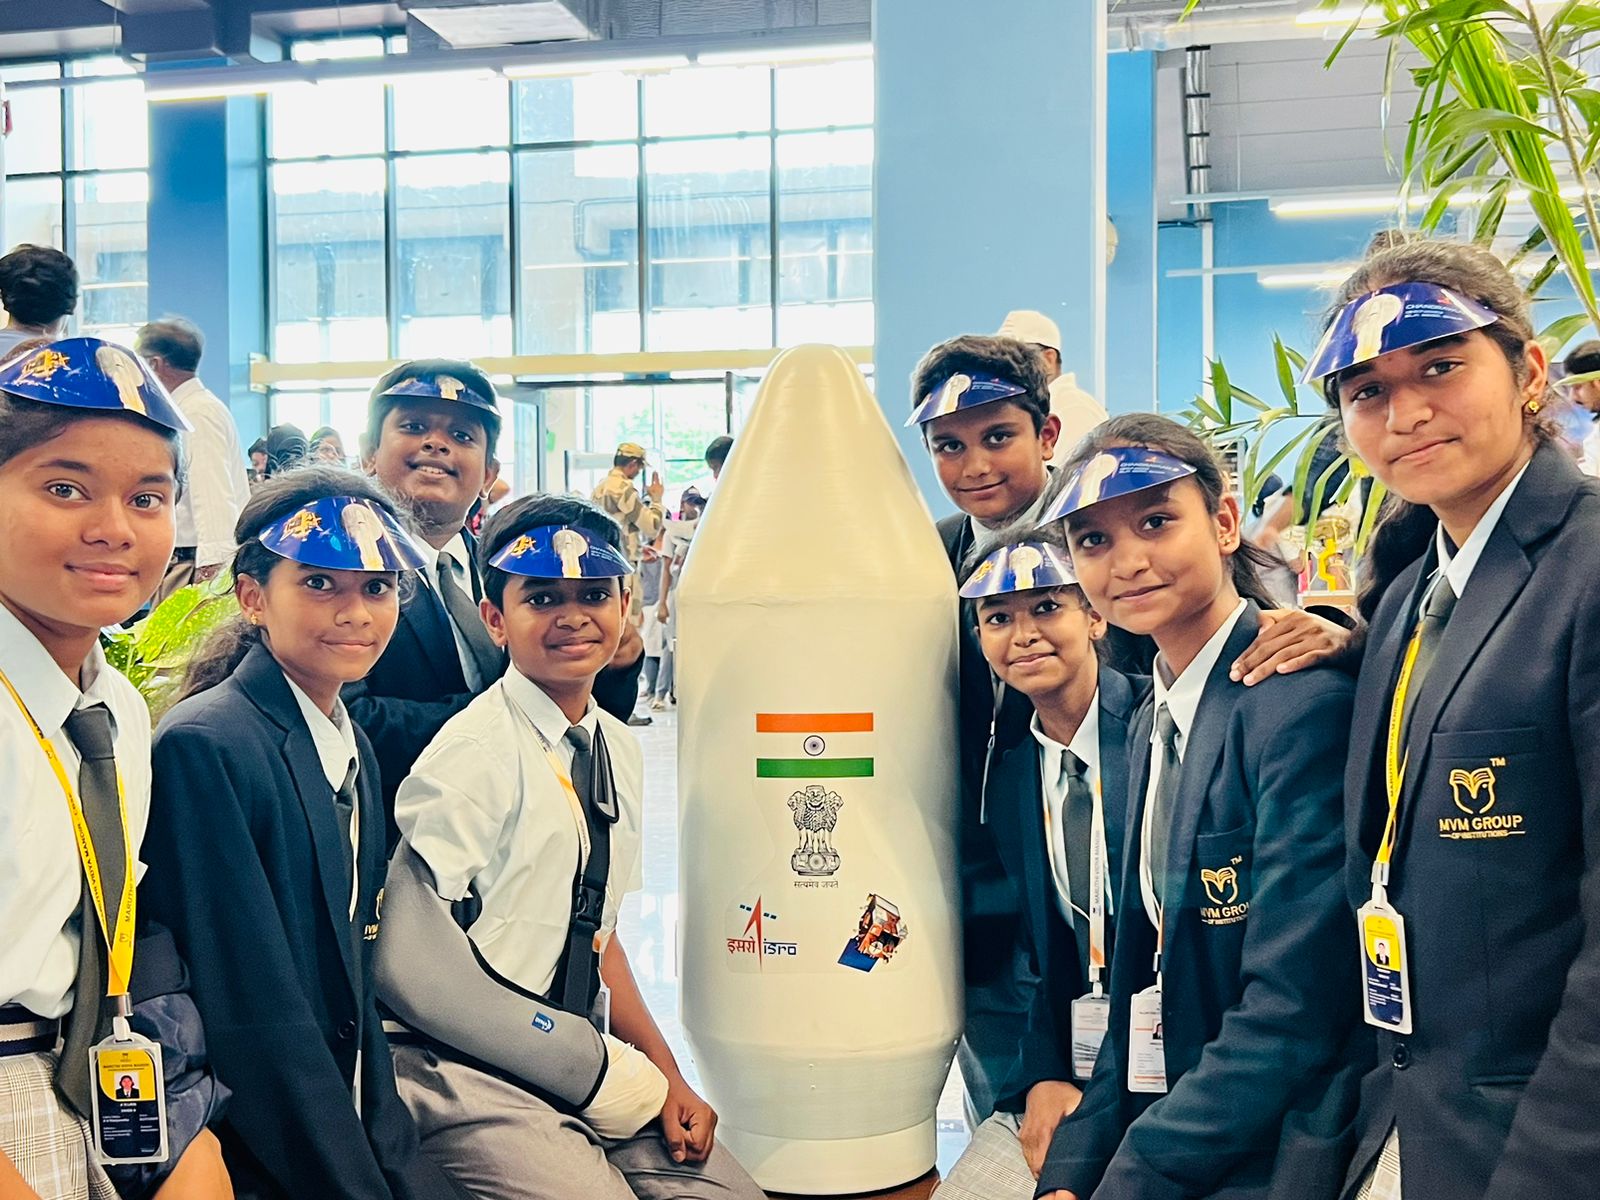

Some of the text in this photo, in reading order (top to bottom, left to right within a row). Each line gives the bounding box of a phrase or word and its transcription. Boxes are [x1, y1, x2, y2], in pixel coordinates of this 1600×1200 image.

[1489, 757, 1506, 767] TM
[1439, 815, 1523, 832] MVM GROUP
[77, 823, 89, 857] MANDIR
[87, 858, 96, 885] VIDYA
[726, 936, 755, 954] इसरो
